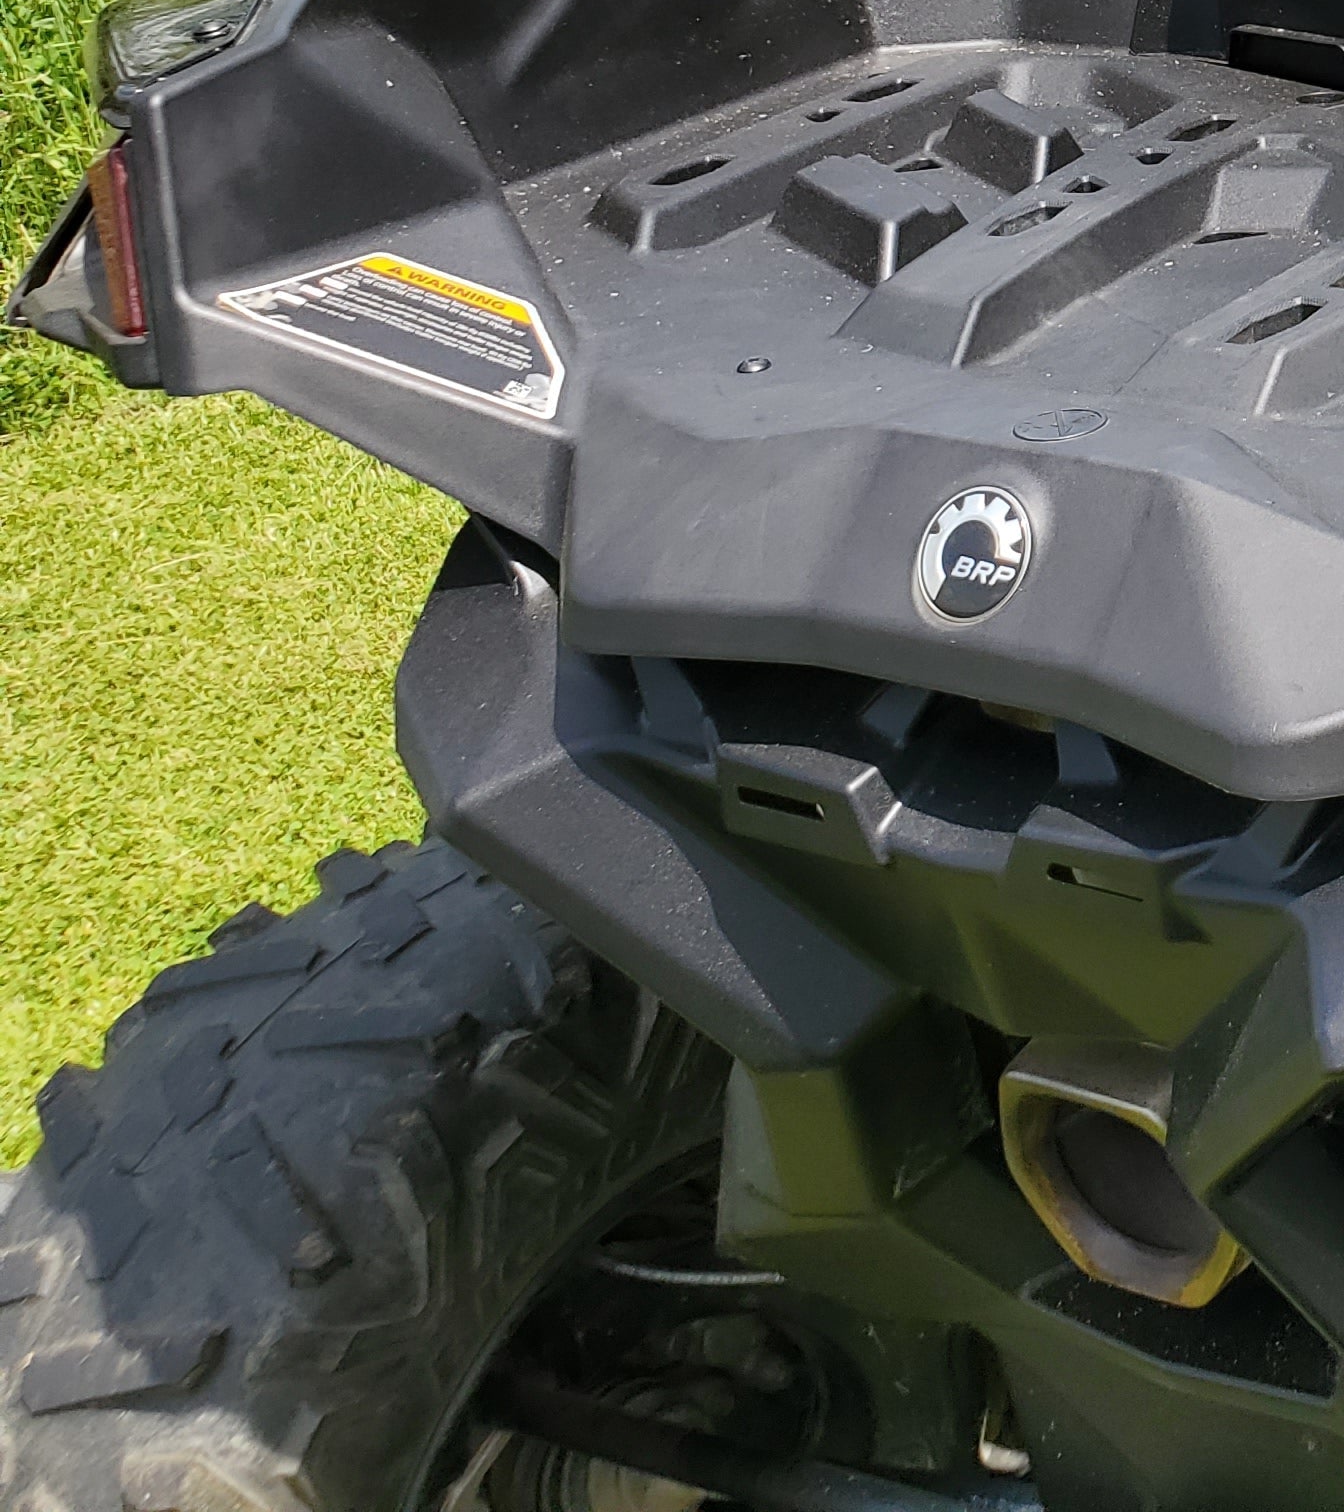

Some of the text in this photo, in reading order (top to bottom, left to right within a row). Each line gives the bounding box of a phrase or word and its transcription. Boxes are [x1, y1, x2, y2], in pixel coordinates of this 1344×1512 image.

[372, 280, 407, 297] control
[408, 271, 506, 311] WARNING
[950, 555, 1016, 587] BRP
